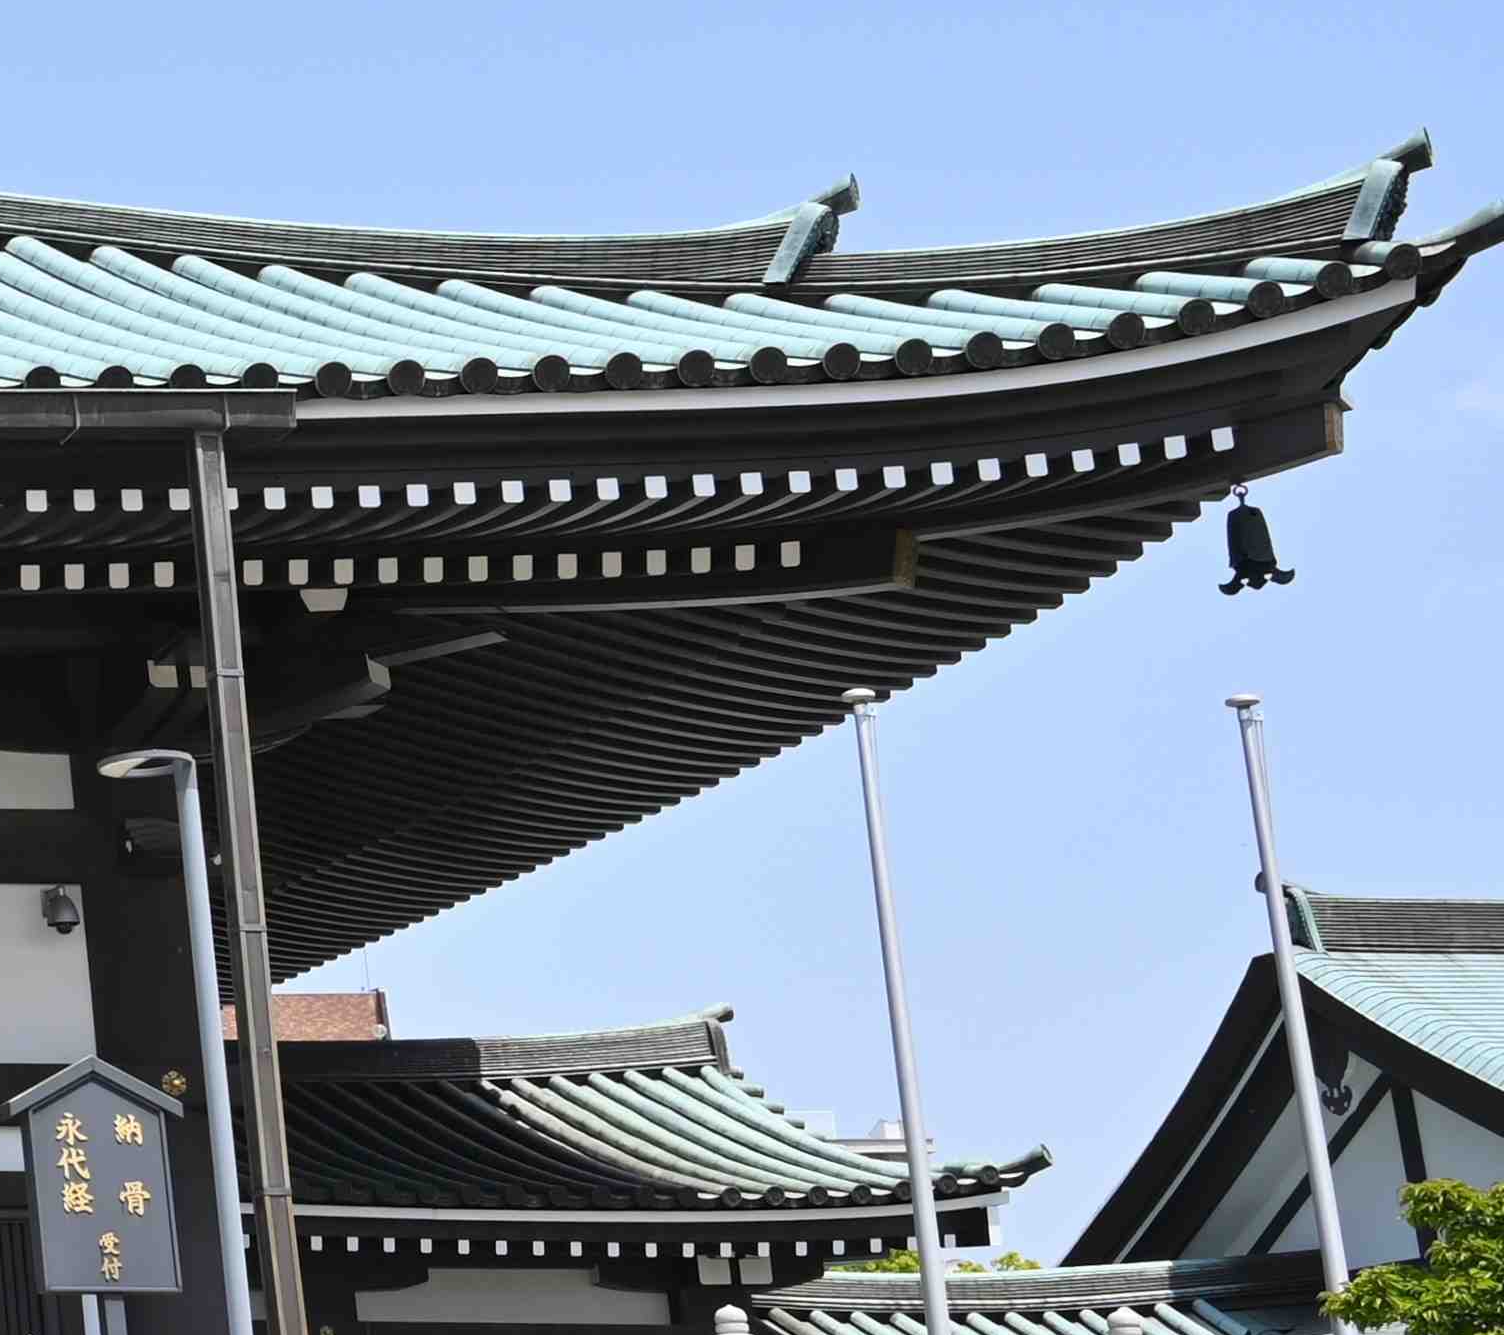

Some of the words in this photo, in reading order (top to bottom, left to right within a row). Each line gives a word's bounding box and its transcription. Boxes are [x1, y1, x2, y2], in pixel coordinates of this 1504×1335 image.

[55, 1112, 95, 1214] 永代経
[113, 1113, 151, 1216] 納骨
[98, 1231, 123, 1281] 受付
